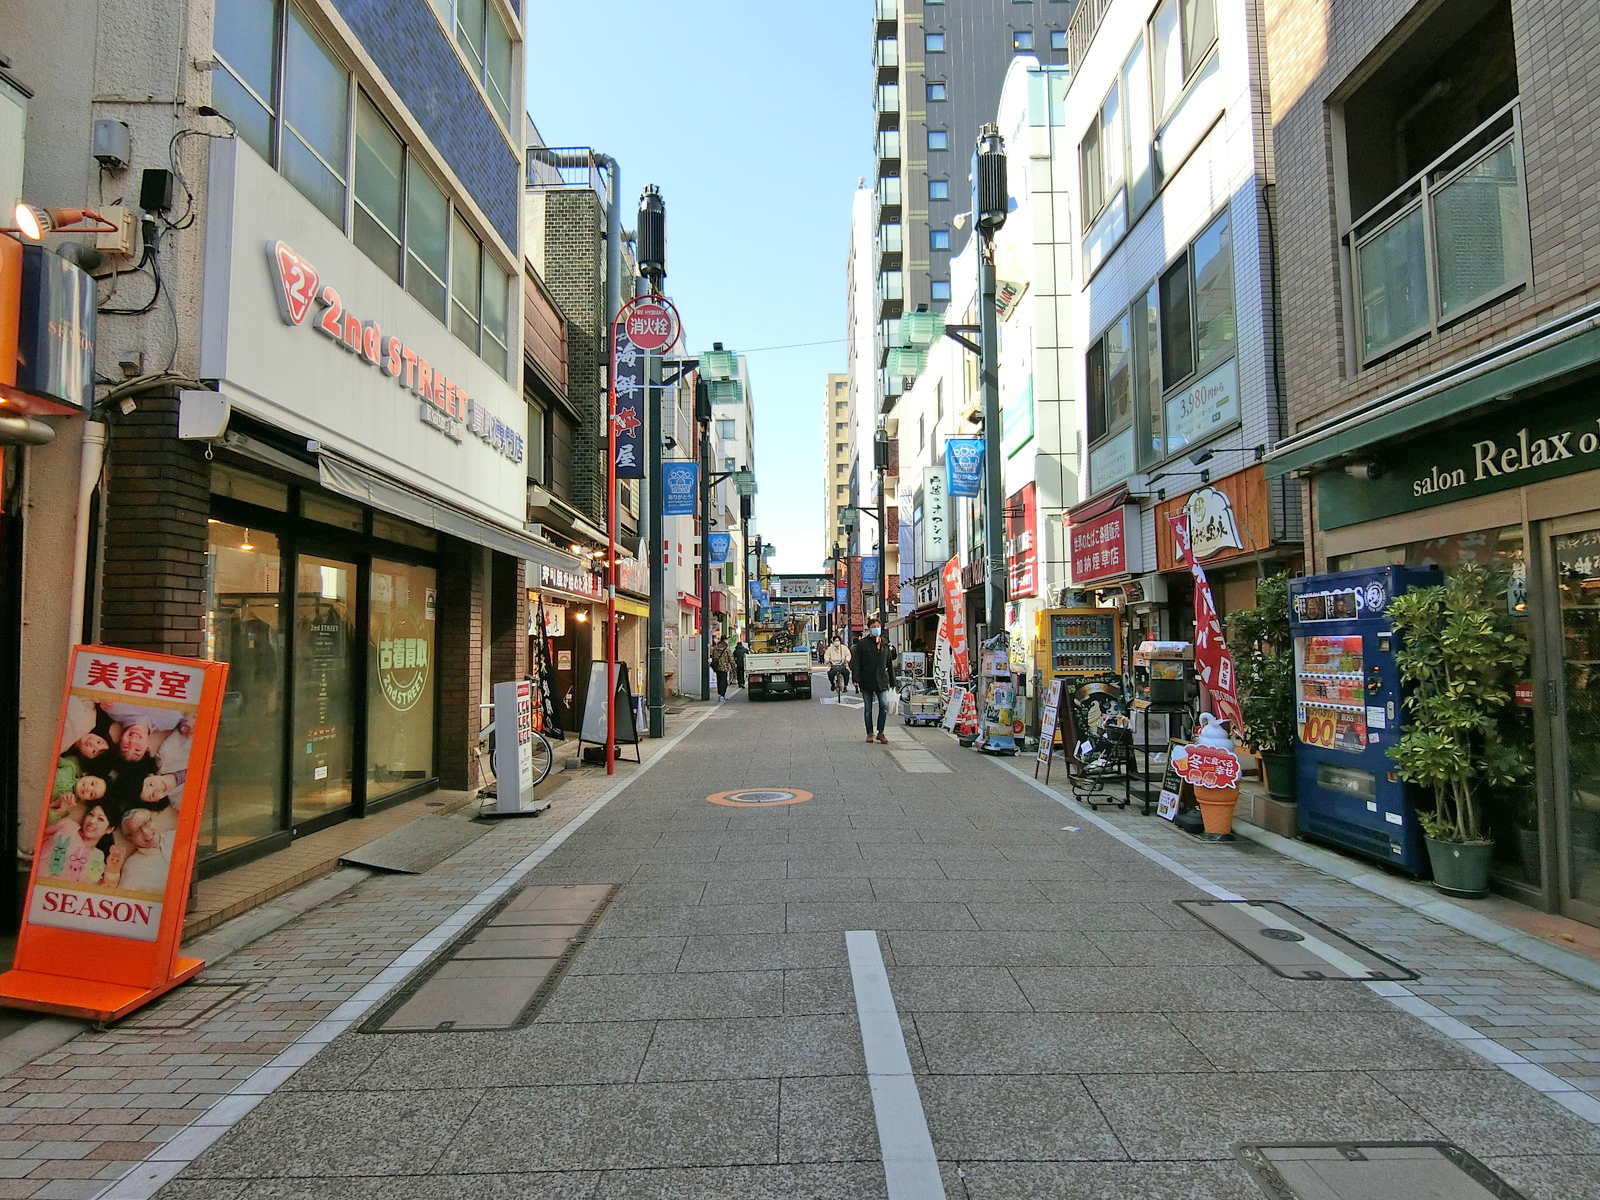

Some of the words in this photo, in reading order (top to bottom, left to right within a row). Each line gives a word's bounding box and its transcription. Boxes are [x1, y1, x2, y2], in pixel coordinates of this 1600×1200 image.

[630, 317, 669, 336] 消火栓
[315, 286, 381, 366] 2nd
[383, 336, 468, 422] STREET
[471, 398, 524, 464] 買取専門店
[1412, 465, 1467, 497] salon
[1471, 427, 1575, 482] Relax
[1073, 520, 1120, 553] 世界のたばこ各種販売
[1075, 546, 1119, 575] 加納煙草店
[380, 638, 428, 669] 古着買取
[86, 658, 191, 700] 美容室
[383, 673, 399, 702] 2nd
[397, 671, 424, 705] STREET
[1302, 716, 1334, 747] 100
[1189, 753, 1234, 770] 冬に食べる
[1215, 765, 1234, 777] 幸せ
[42, 891, 154, 926] SEASON
